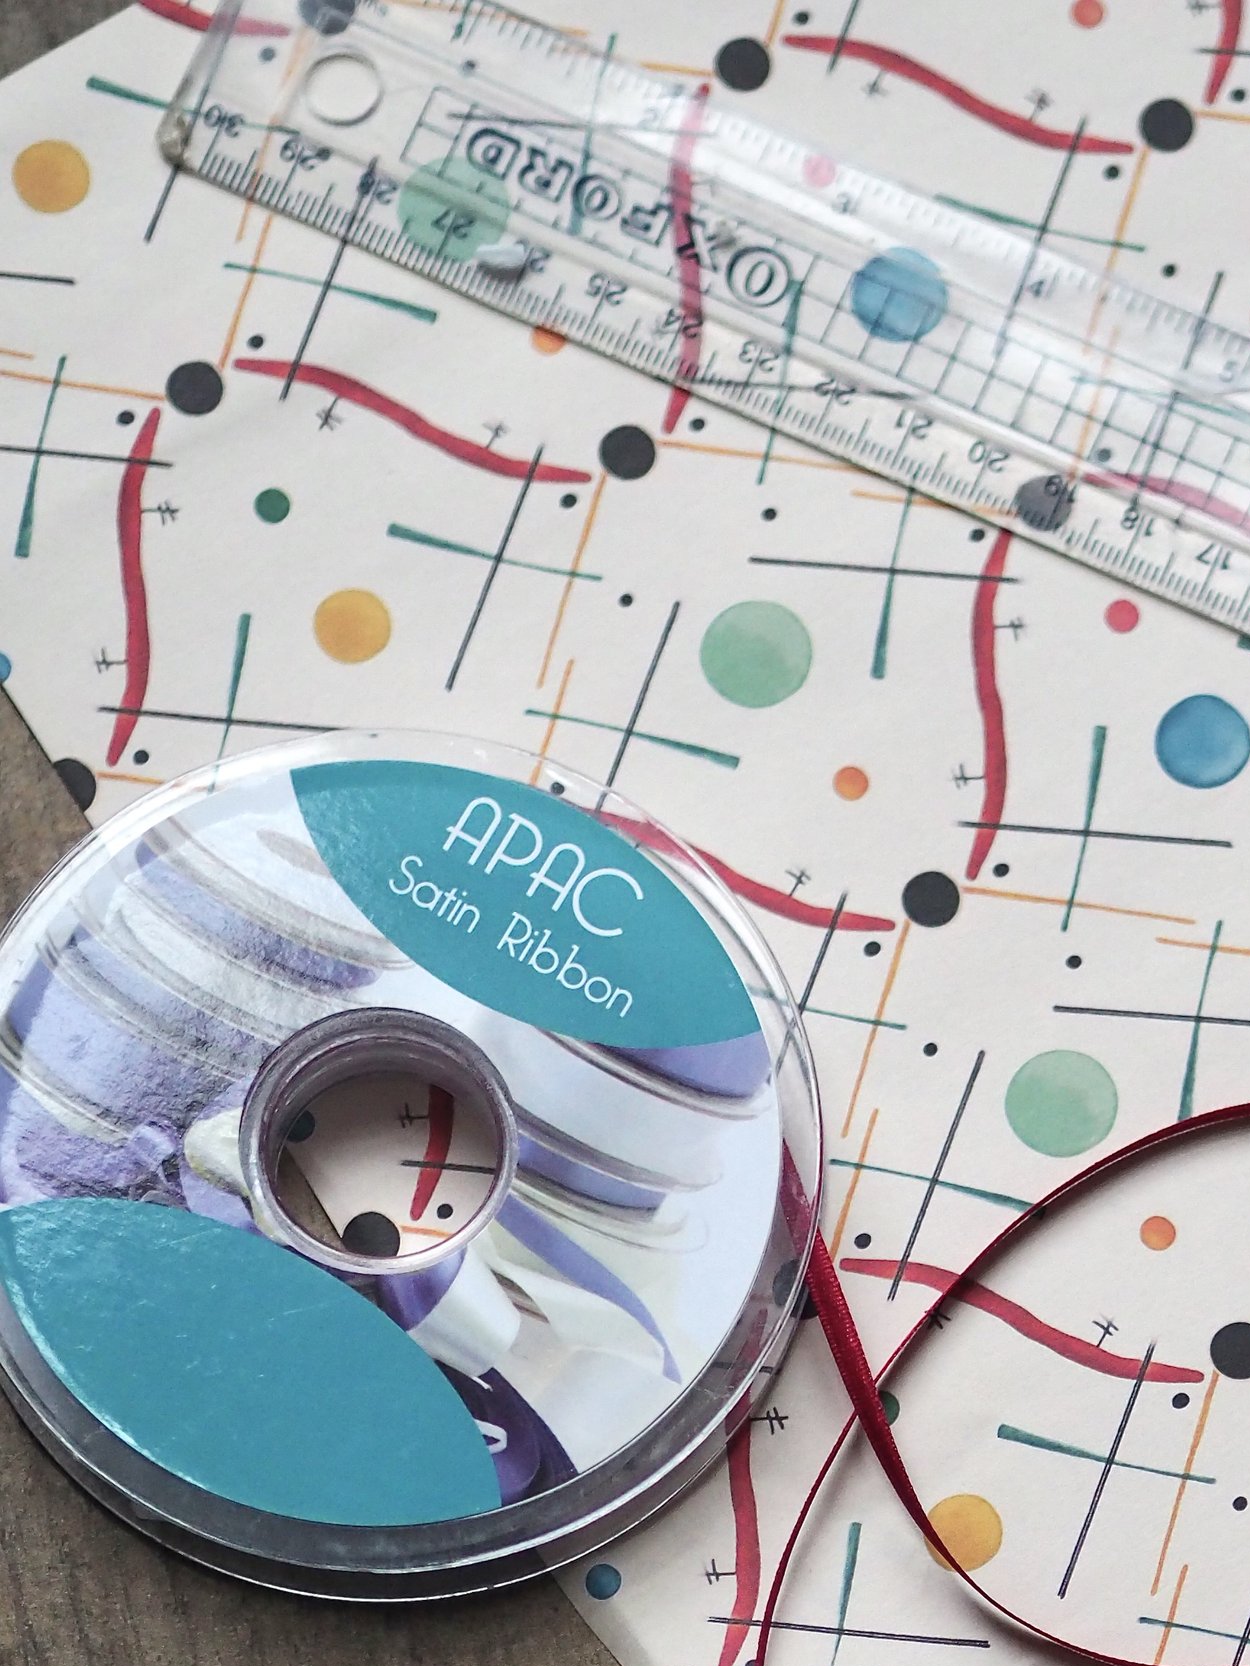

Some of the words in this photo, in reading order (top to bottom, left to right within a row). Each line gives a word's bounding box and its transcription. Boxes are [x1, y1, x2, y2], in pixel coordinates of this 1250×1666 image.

[203, 104, 243, 138] 30
[431, 208, 476, 239] 27
[467, 127, 791, 307] OXFORD
[586, 272, 628, 306] 25
[656, 308, 702, 338] 24
[1028, 278, 1046, 297] 4
[1219, 360, 1238, 383] 5
[739, 340, 780, 371] 23
[814, 377, 856, 405] 22
[896, 412, 933, 440] 21
[967, 439, 1010, 473] 20
[1120, 505, 1154, 536] 18
[1196, 543, 1231, 570] 17
[442, 796, 644, 937] APAC
[389, 855, 481, 934] Satin
[496, 911, 634, 1018] Ribbon
